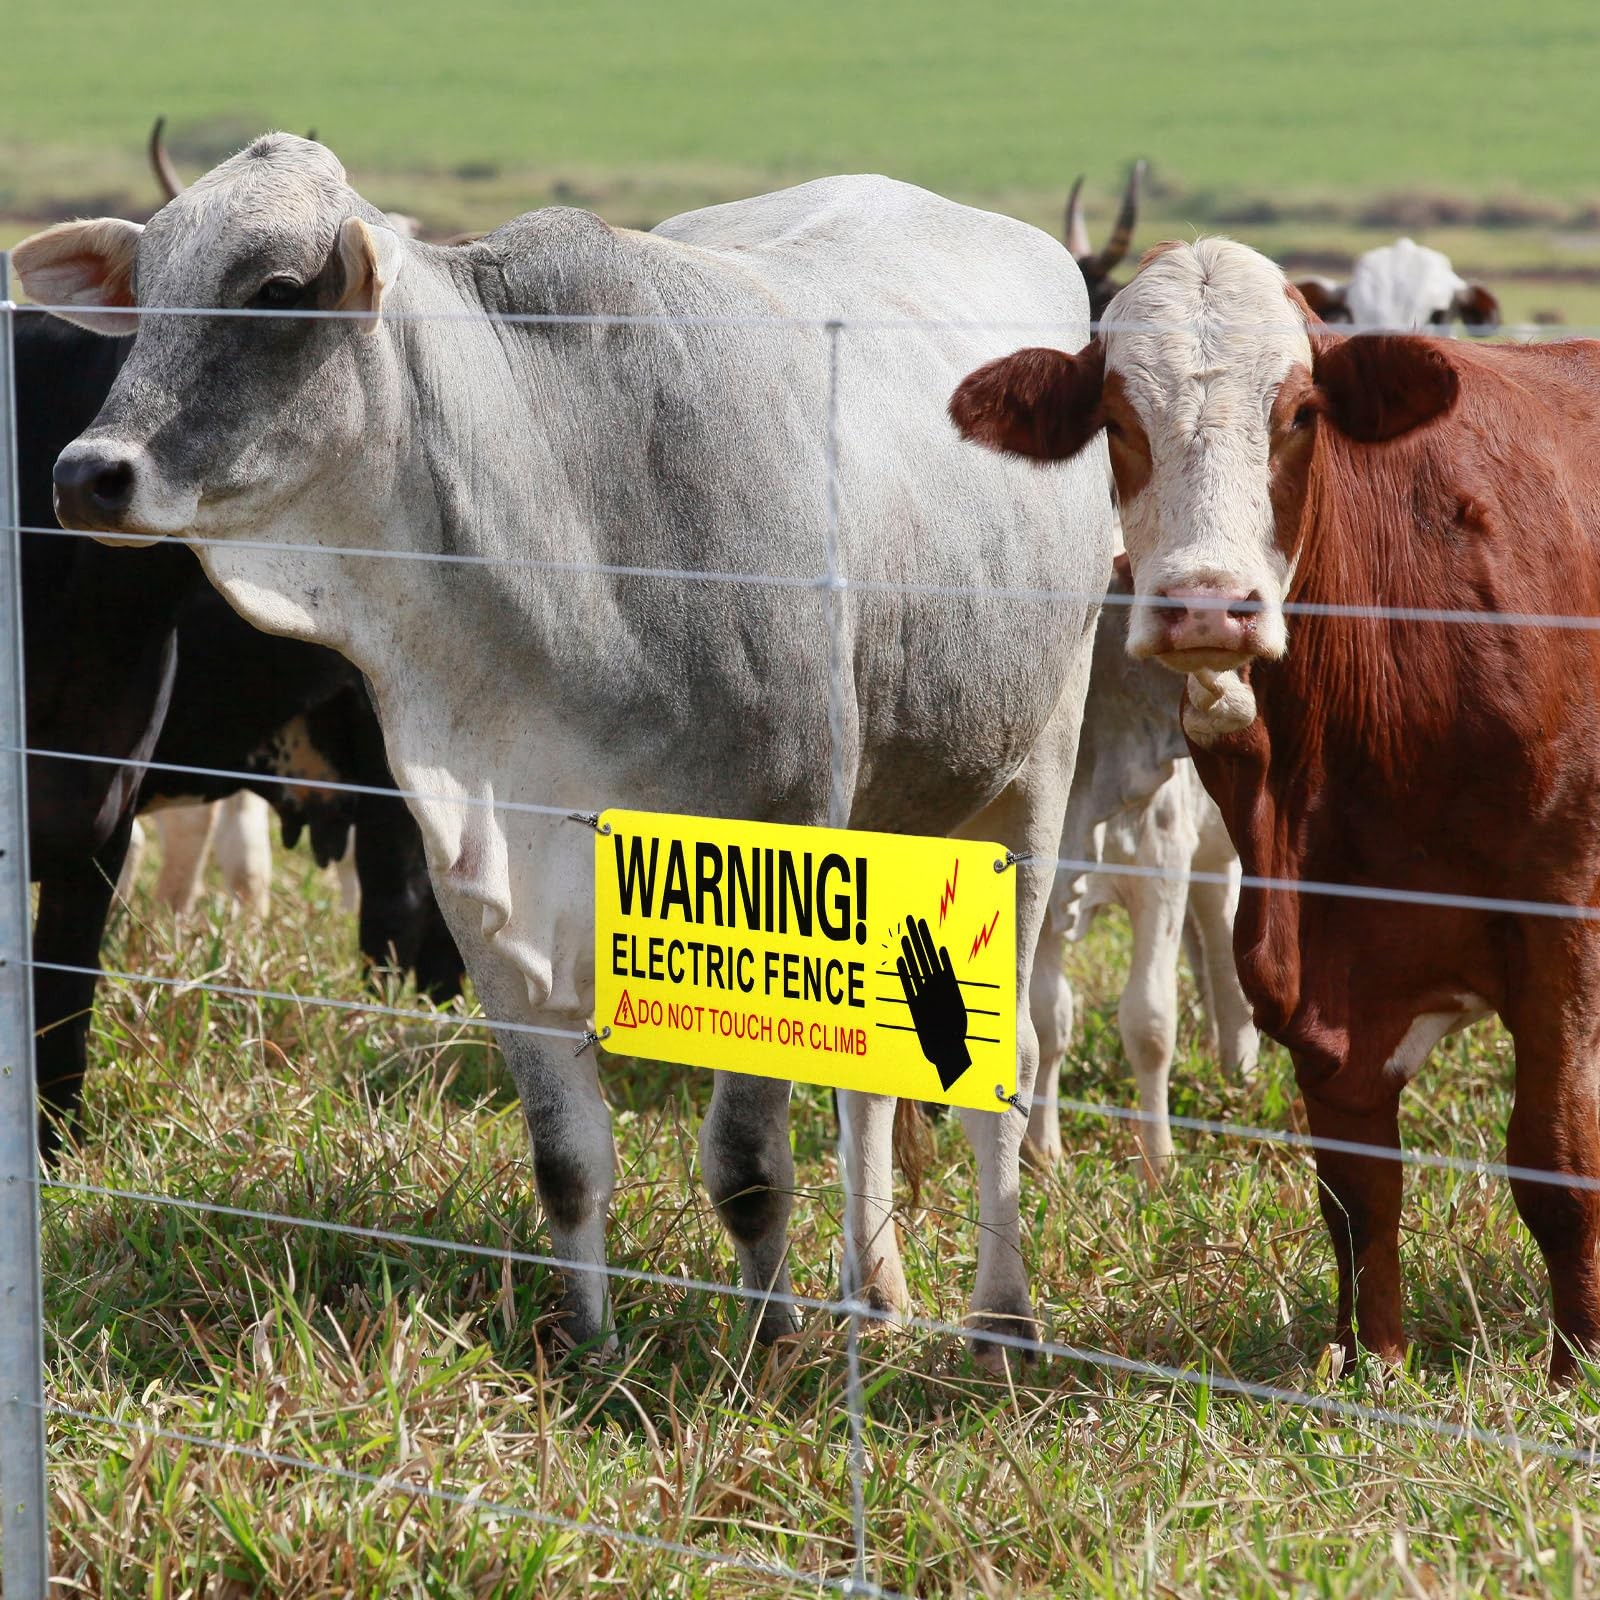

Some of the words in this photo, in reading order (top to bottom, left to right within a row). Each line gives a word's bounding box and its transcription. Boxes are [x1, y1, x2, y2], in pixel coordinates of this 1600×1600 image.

[614, 834, 868, 946] WARNING!
[612, 932, 755, 993] ELECTRIC
[764, 951, 866, 1009] FENCE
[638, 999, 663, 1027] DO
[668, 1002, 705, 1032] NOT
[709, 1009, 772, 1042] TOUCH
[778, 1018, 804, 1046] OR
[809, 1023, 867, 1057] CLIMB
